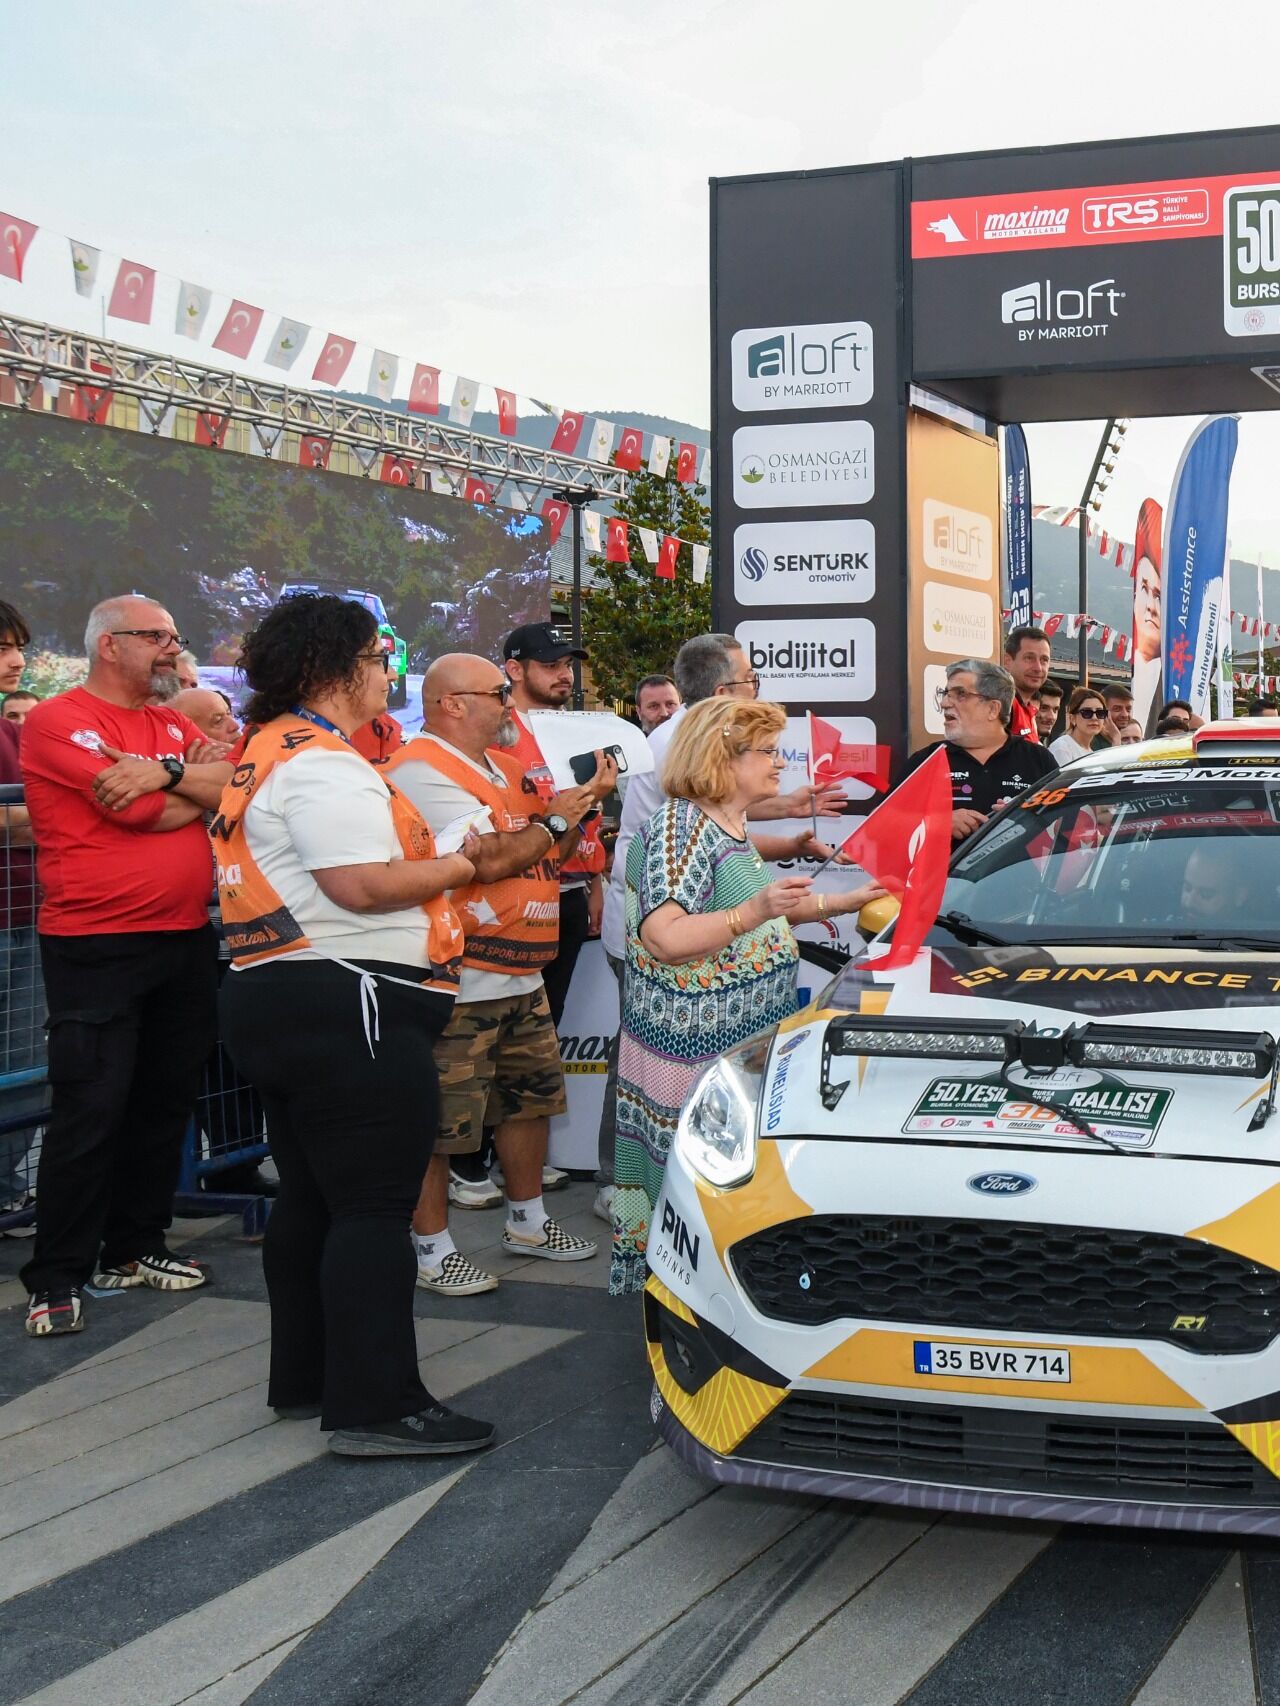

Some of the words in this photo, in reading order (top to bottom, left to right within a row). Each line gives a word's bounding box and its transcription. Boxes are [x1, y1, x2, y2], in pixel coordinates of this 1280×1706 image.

[1162, 196, 1188, 204] TÜRKİYE
[984, 206, 1069, 231] maxima
[1087, 198, 1159, 228] TRS
[1162, 213, 1204, 223] ŞAMPİYONASI
[991, 229, 1019, 238] MOTOR
[1023, 227, 1059, 236] YAĞLARI
[1001, 279, 1121, 323] aloft
[1018, 329, 1034, 341] BY
[1038, 325, 1108, 340] MARRIOTT
[748, 332, 863, 378] aloft
[764, 386, 780, 398] BY
[784, 382, 852, 396] MARRIOTT
[768, 448, 867, 468] OSMANGAZİ
[769, 467, 867, 484] BELEDİYESİ
[933, 514, 984, 559] aloft
[808, 572, 857, 582] OTOMOTİV
[1178, 526, 1197, 629] Assistance
[749, 639, 855, 672] bidijital
[1021, 788, 1070, 809] 36
[1015, 968, 1252, 989] BINANCE
[980, 1175, 1021, 1192] Ford
[660, 1198, 700, 1273] PIN
[656, 1244, 691, 1286] DRINKS
[1173, 1315, 1206, 1330] R1
[919, 1364, 929, 1372] TR
[935, 1350, 963, 1369] 35
[969, 1351, 1018, 1373] BVR
[1024, 1355, 1065, 1375] 714
